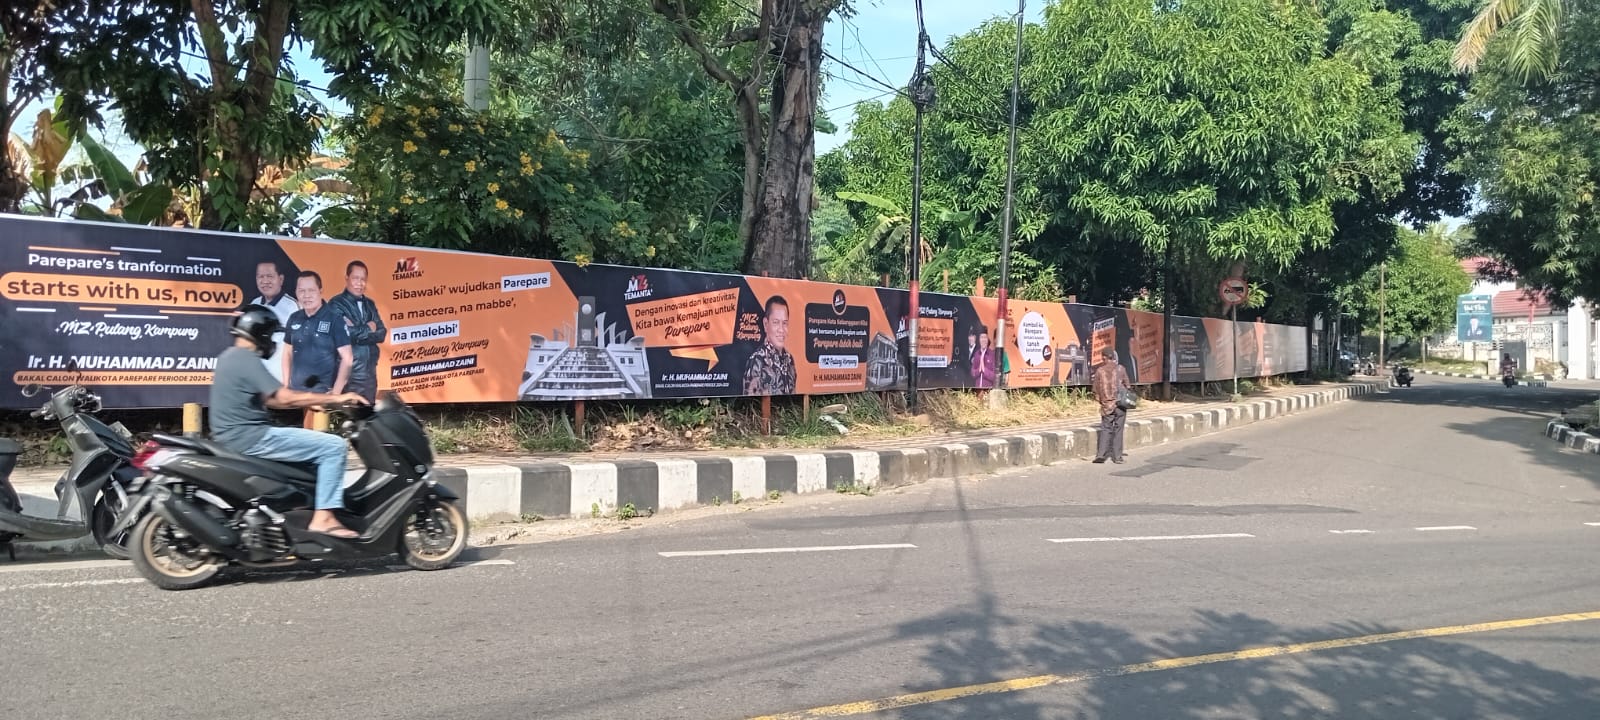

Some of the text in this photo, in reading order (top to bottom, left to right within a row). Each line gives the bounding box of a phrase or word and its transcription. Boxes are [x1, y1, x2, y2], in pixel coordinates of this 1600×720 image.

[28, 253, 222, 276] Parepare's tranformation
[7, 280, 237, 304] starts with us, now!
[392, 277, 548, 300] Sibawaki' wujudkan Parepare
[390, 313, 404, 321] na
[407, 307, 458, 319] maccera,
[459, 304, 473, 313] na
[635, 292, 737, 318] Dengan inovasi dan kreativitas,
[635, 303, 736, 330] Kita bawa Kemajuan untuk
[94, 322, 142, 340] Pulang
[143, 323, 199, 340] Kampung
[393, 324, 458, 341] na malebbi'
[664, 321, 710, 339] Parepare
[417, 345, 449, 358] Pulang
[450, 339, 490, 352] Kampung
[28, 355, 218, 370] Ir. H. MUHAMMAD ZAINI
[392, 358, 475, 376] Ir. H. MUHAMMAD ZAINI
